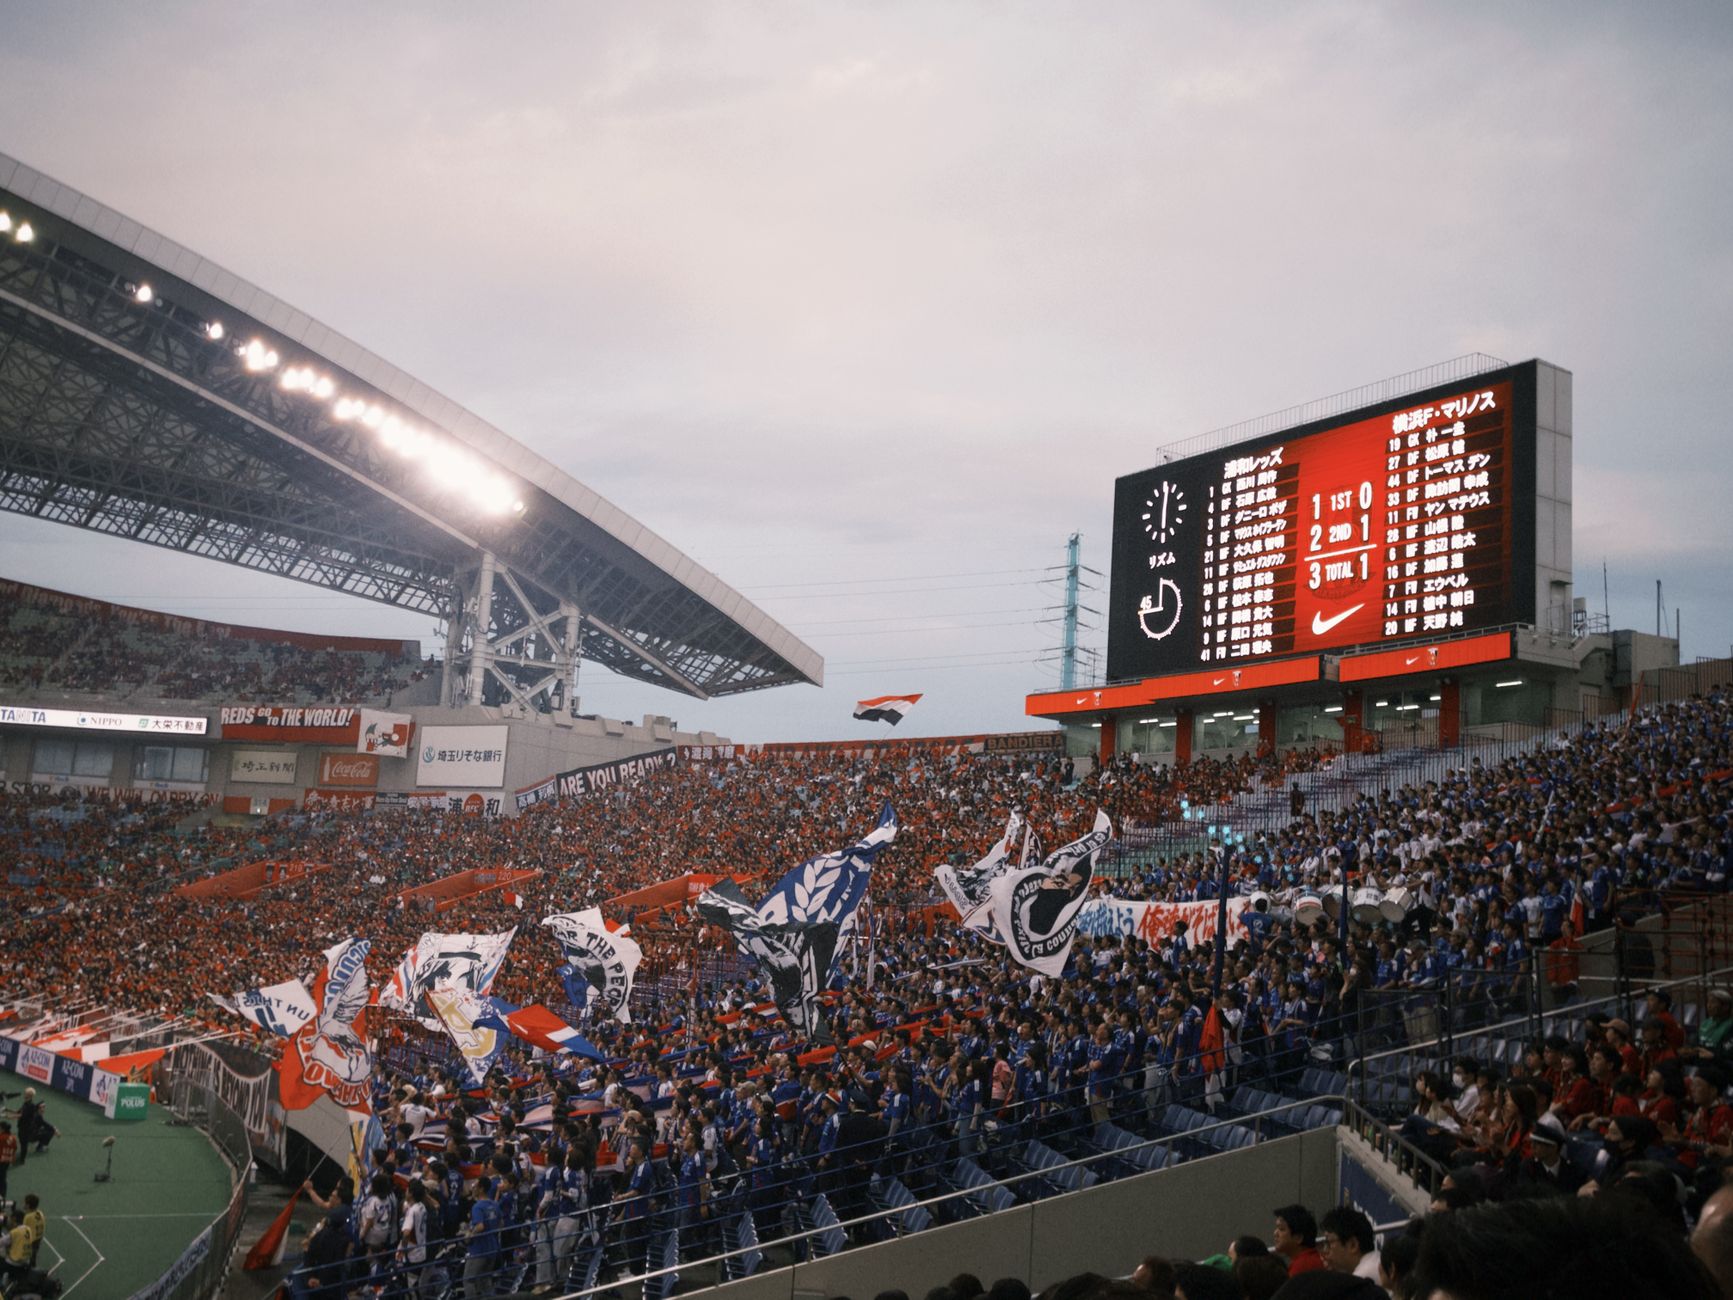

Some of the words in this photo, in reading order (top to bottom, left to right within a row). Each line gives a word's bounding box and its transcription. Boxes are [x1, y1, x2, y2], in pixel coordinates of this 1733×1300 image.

[1388, 455, 1400, 470] 27
[1407, 450, 1419, 465] DF
[1387, 473, 1400, 487] 44
[1407, 469, 1418, 483] DF
[1425, 459, 1464, 480] トーマス
[1467, 453, 1490, 470] デン
[1209, 486, 1213, 497] 1
[1406, 487, 1418, 502] DF
[1208, 502, 1213, 513] 4
[1312, 493, 1320, 520] 1
[1330, 490, 1352, 511] 1ST
[1360, 481, 1372, 509] 0
[1388, 510, 1398, 524] 11
[1424, 501, 1445, 516] ヤン
[1447, 491, 1489, 510] マテウス
[1207, 534, 1212, 546] 5
[1310, 524, 1322, 552] 2
[1329, 523, 1352, 543] 2ND
[1361, 514, 1369, 541] 1
[1149, 552, 1176, 569] リズム
[1204, 550, 1213, 563] 21
[1389, 547, 1395, 560] 6
[1204, 566, 1212, 579] 11
[1309, 562, 1321, 590] 3
[1325, 561, 1354, 581] TOTAL
[1360, 553, 1368, 580] 1
[1387, 565, 1398, 579] 16
[1388, 584, 1395, 597] 7
[1140, 595, 1152, 609] 45
[1204, 599, 1210, 611] 6
[1386, 602, 1397, 616] 14
[1202, 614, 1211, 627] 14
[1385, 620, 1397, 635] 20
[1200, 648, 1209, 661] 41
[90, 717, 122, 727] NIPPO
[221, 708, 256, 725] REDS
[257, 708, 272, 717] GO
[267, 717, 279, 726] TO
[280, 708, 303, 727] THE
[303, 708, 355, 727] WORLD!
[152, 720, 205, 732] 大栄不動産
[987, 734, 1064, 750] BANDIERA
[437, 750, 502, 762] 埼玉りそな銀行
[559, 772, 585, 796] ARE
[586, 766, 616, 790] YOU
[486, 797, 500, 816] 和
[587, 932, 616, 960] THE
